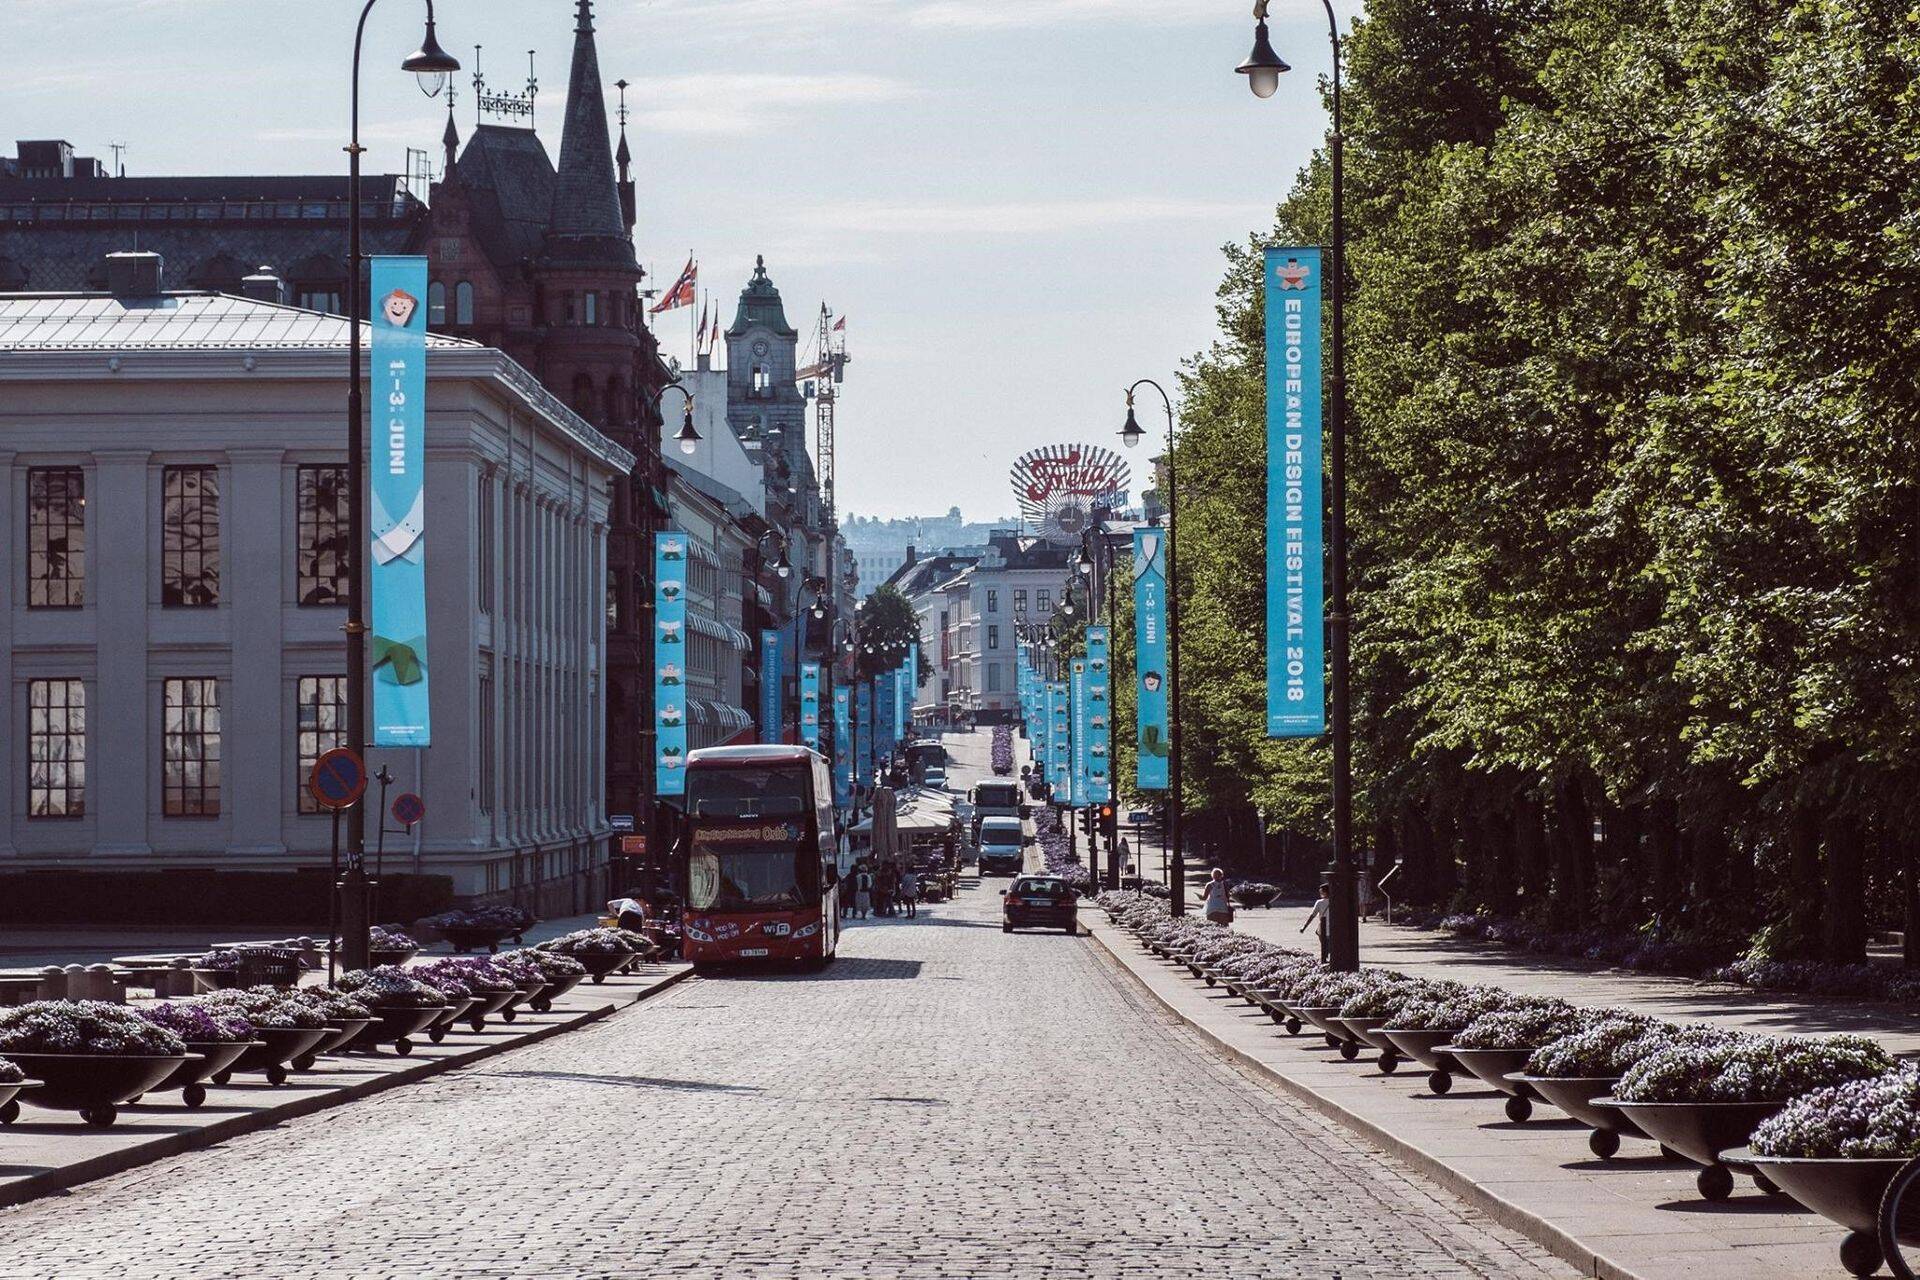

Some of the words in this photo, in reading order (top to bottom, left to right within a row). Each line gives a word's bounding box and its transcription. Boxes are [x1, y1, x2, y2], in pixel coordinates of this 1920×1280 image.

[1285, 299, 1302, 428] EUROPEAN
[389, 419, 406, 474] JUNI
[1285, 435, 1303, 521] DESIGN
[1286, 528, 1304, 641] FESTIVAL
[1146, 613, 1156, 644] JUNI
[1287, 647, 1304, 701] 2018
